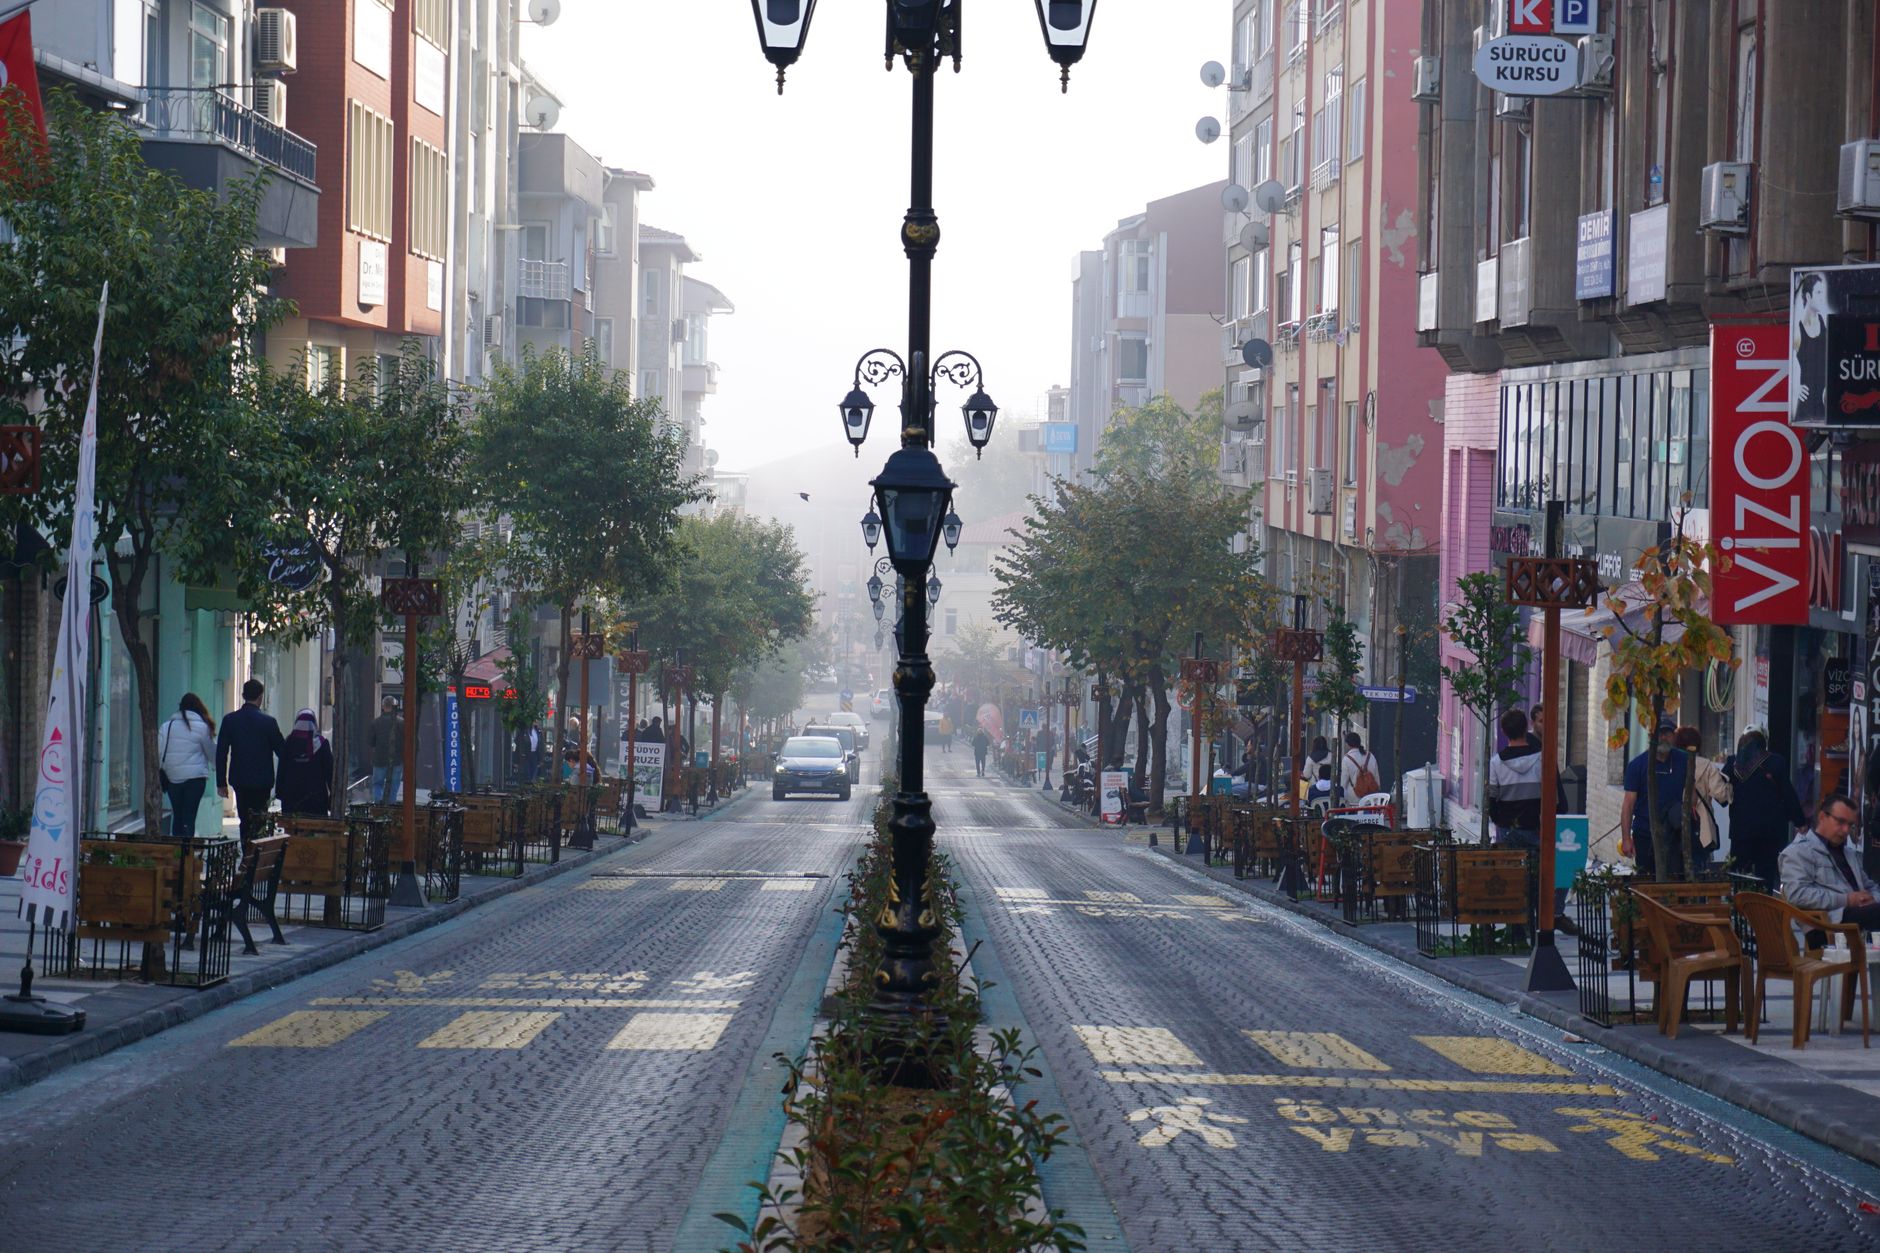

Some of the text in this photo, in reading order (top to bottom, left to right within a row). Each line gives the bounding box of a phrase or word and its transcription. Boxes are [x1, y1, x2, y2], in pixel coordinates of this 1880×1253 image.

[1514, 0, 1543, 25] K
[1567, 0, 1583, 22] P
[1490, 42, 1567, 62] SÜRÜCÜ
[1496, 66, 1560, 81] KURSU
[1839, 354, 1880, 381] SÜR
[624, 755, 660, 765] FRUZE
[1273, 1098, 1518, 1129] önce
[1289, 1126, 1562, 1157] yaya
